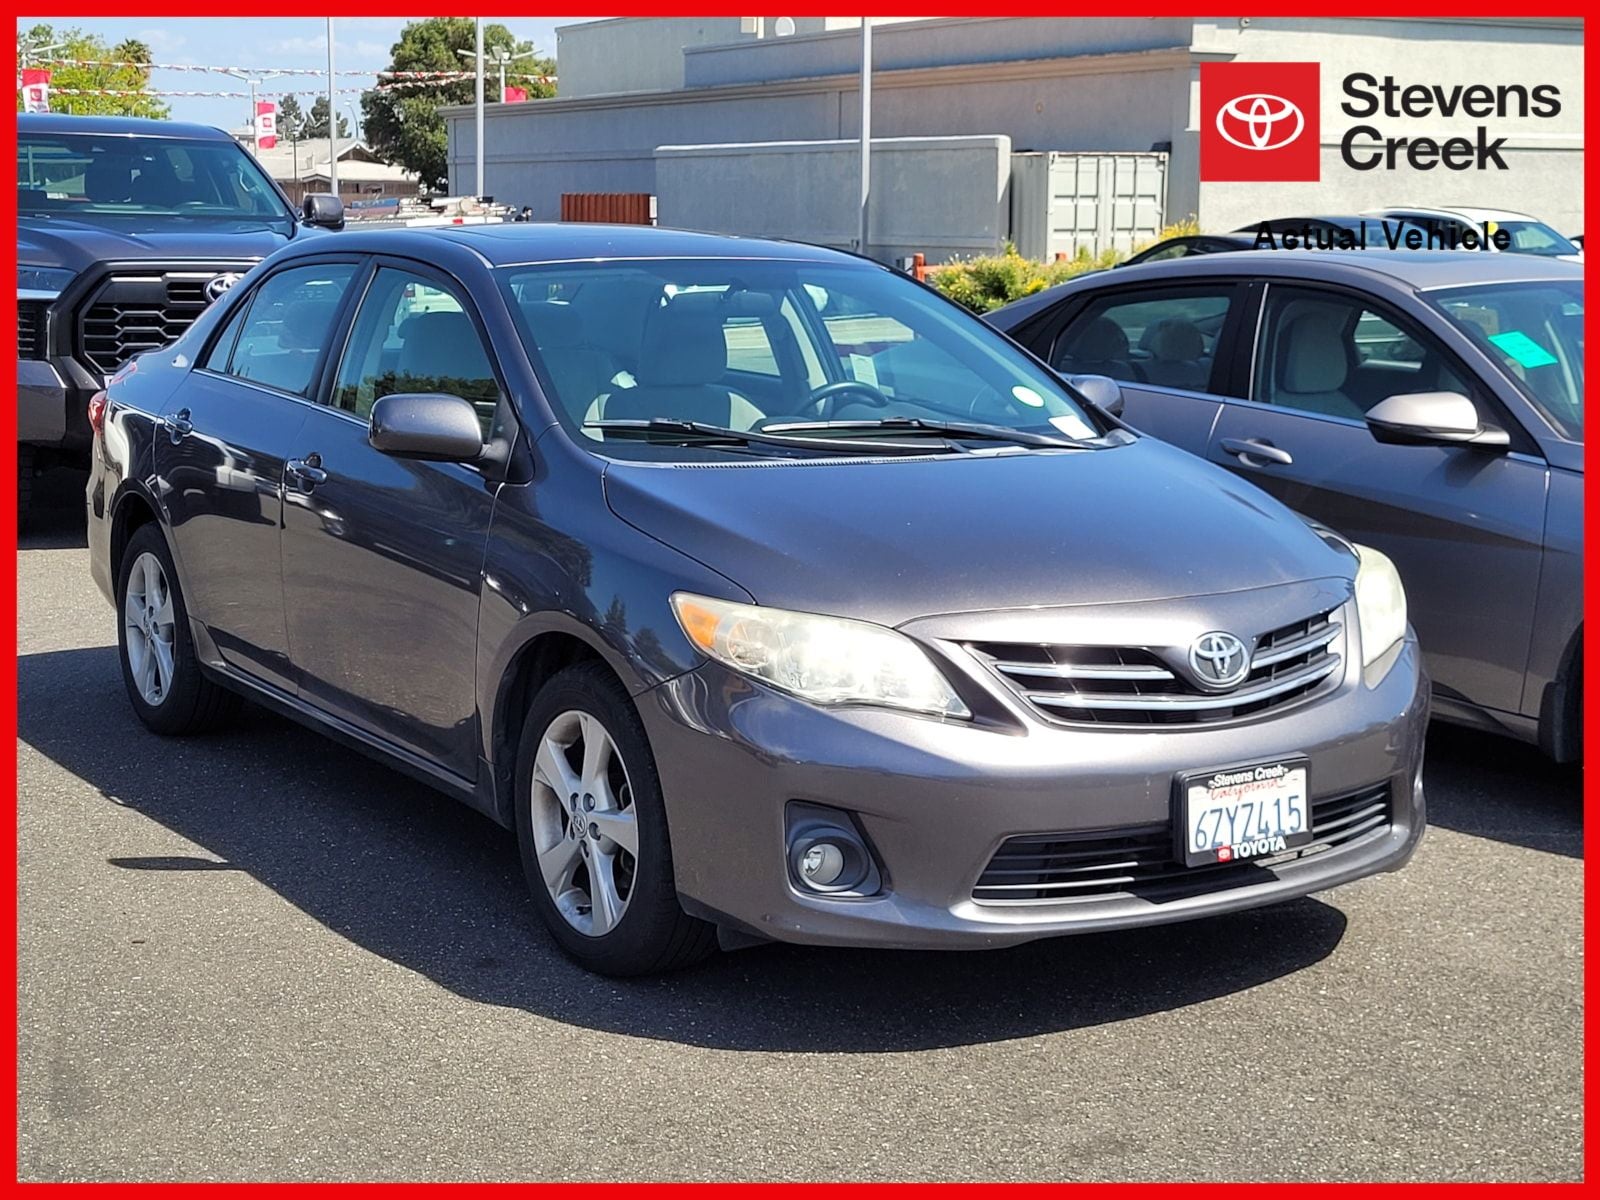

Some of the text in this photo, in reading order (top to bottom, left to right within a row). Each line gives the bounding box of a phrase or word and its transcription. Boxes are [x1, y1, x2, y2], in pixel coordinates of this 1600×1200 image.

[1214, 764, 1284, 787] Stevens Creek
[1195, 795, 1302, 849] 6ZYZ415
[1231, 836, 1286, 859] TOYOTA
